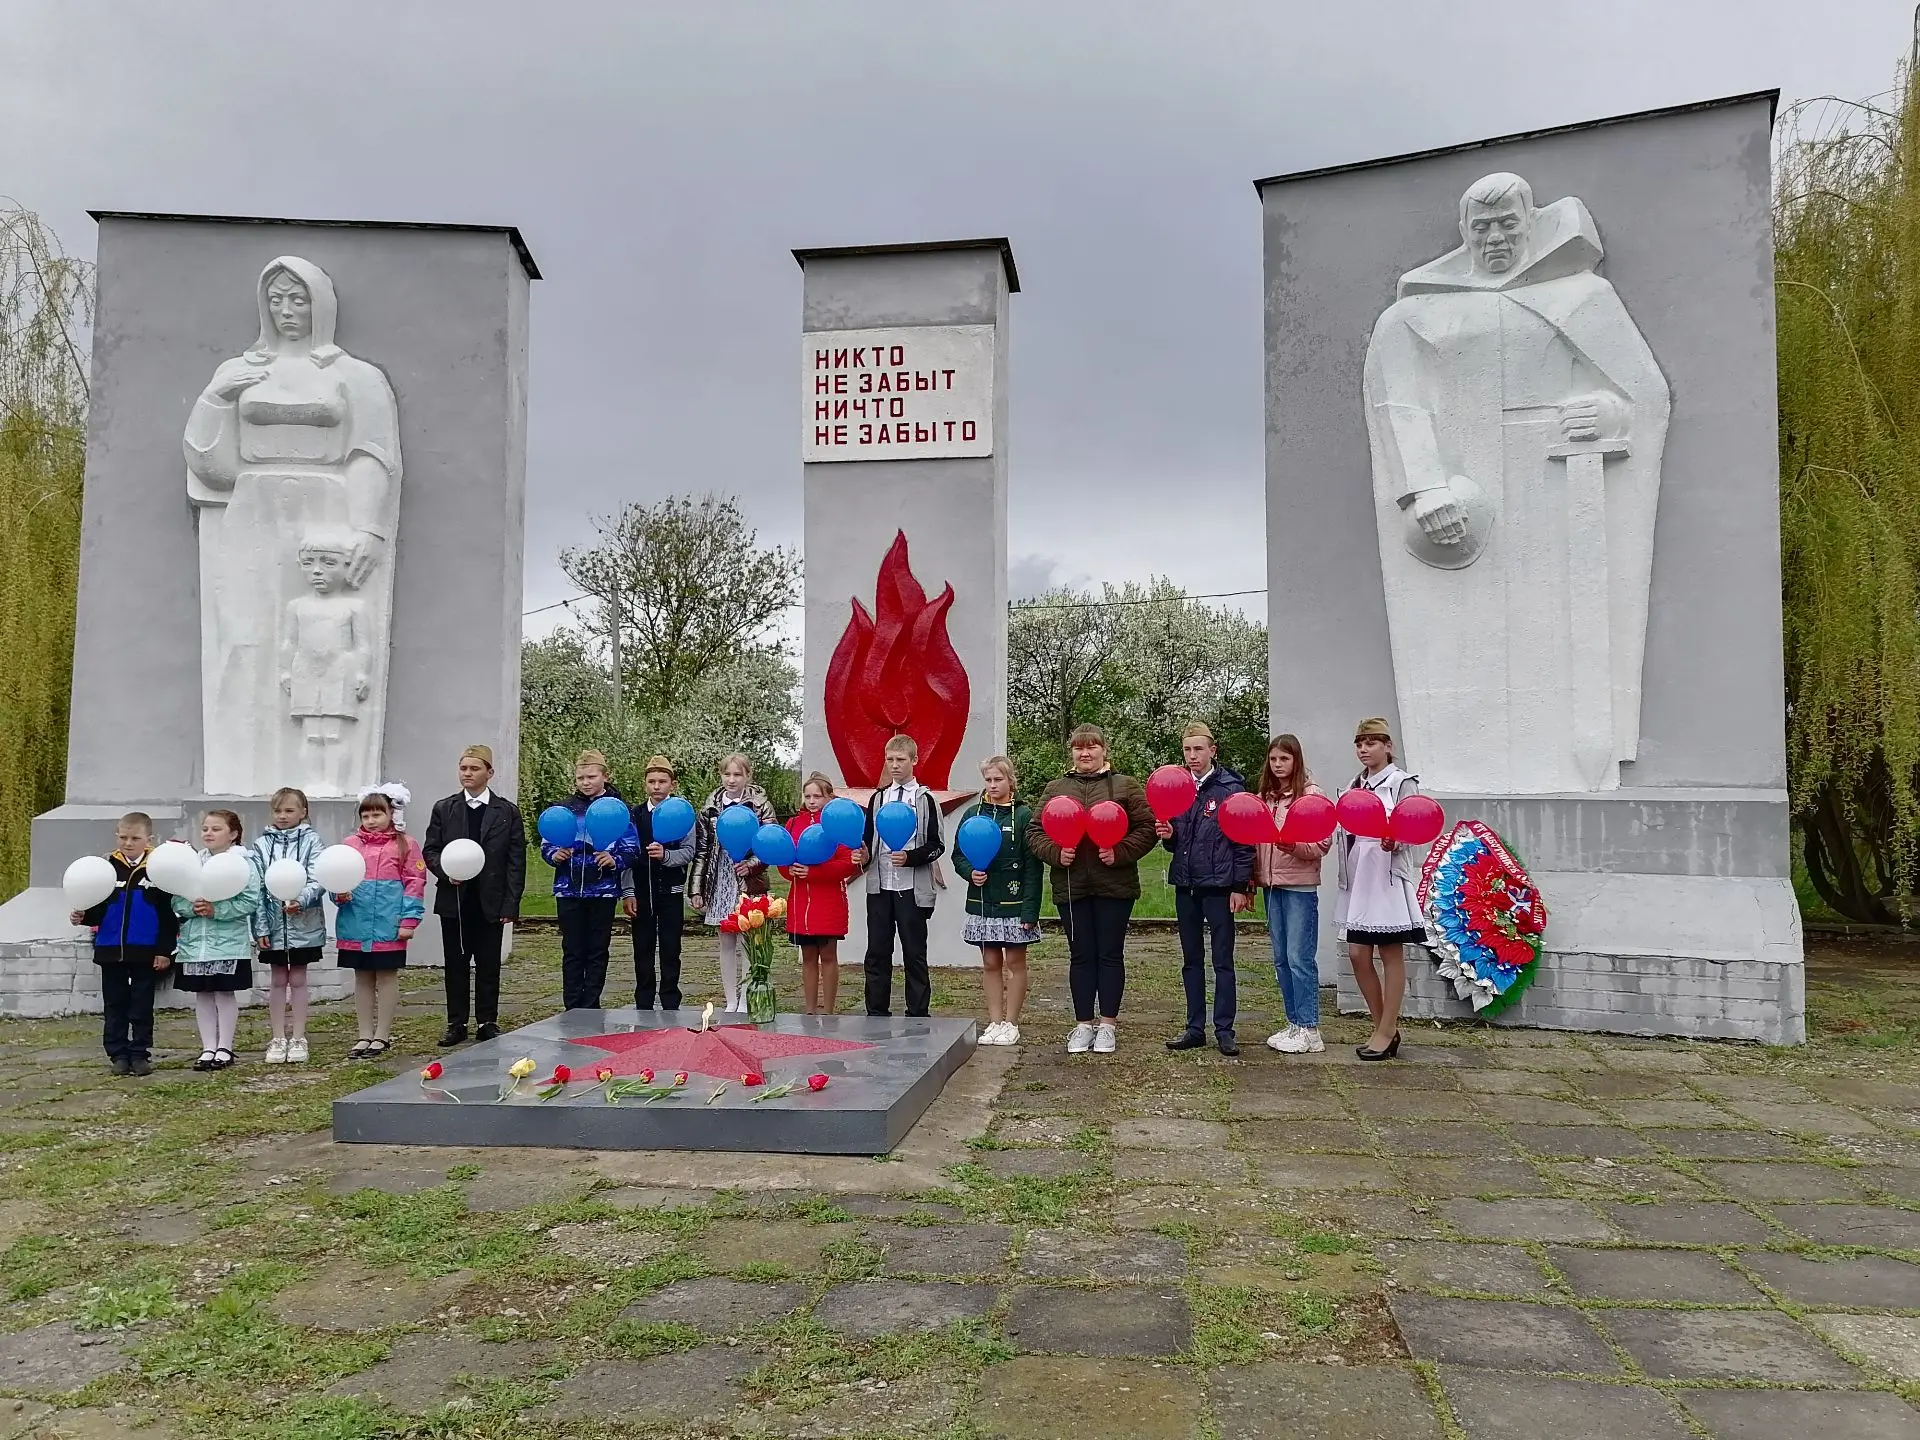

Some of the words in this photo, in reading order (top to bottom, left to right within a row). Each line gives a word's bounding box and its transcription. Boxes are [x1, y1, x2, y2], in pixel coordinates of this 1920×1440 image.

[815, 345, 905, 370] НИКТО
[815, 374, 848, 395] НЕ
[859, 369, 956, 394] ЗАБЫТ
[815, 397, 904, 421] НИЧТО
[815, 424, 848, 446] НЕ
[858, 420, 977, 445] ЗАБЫТО
[1427, 830, 1454, 863] ВОИНА
